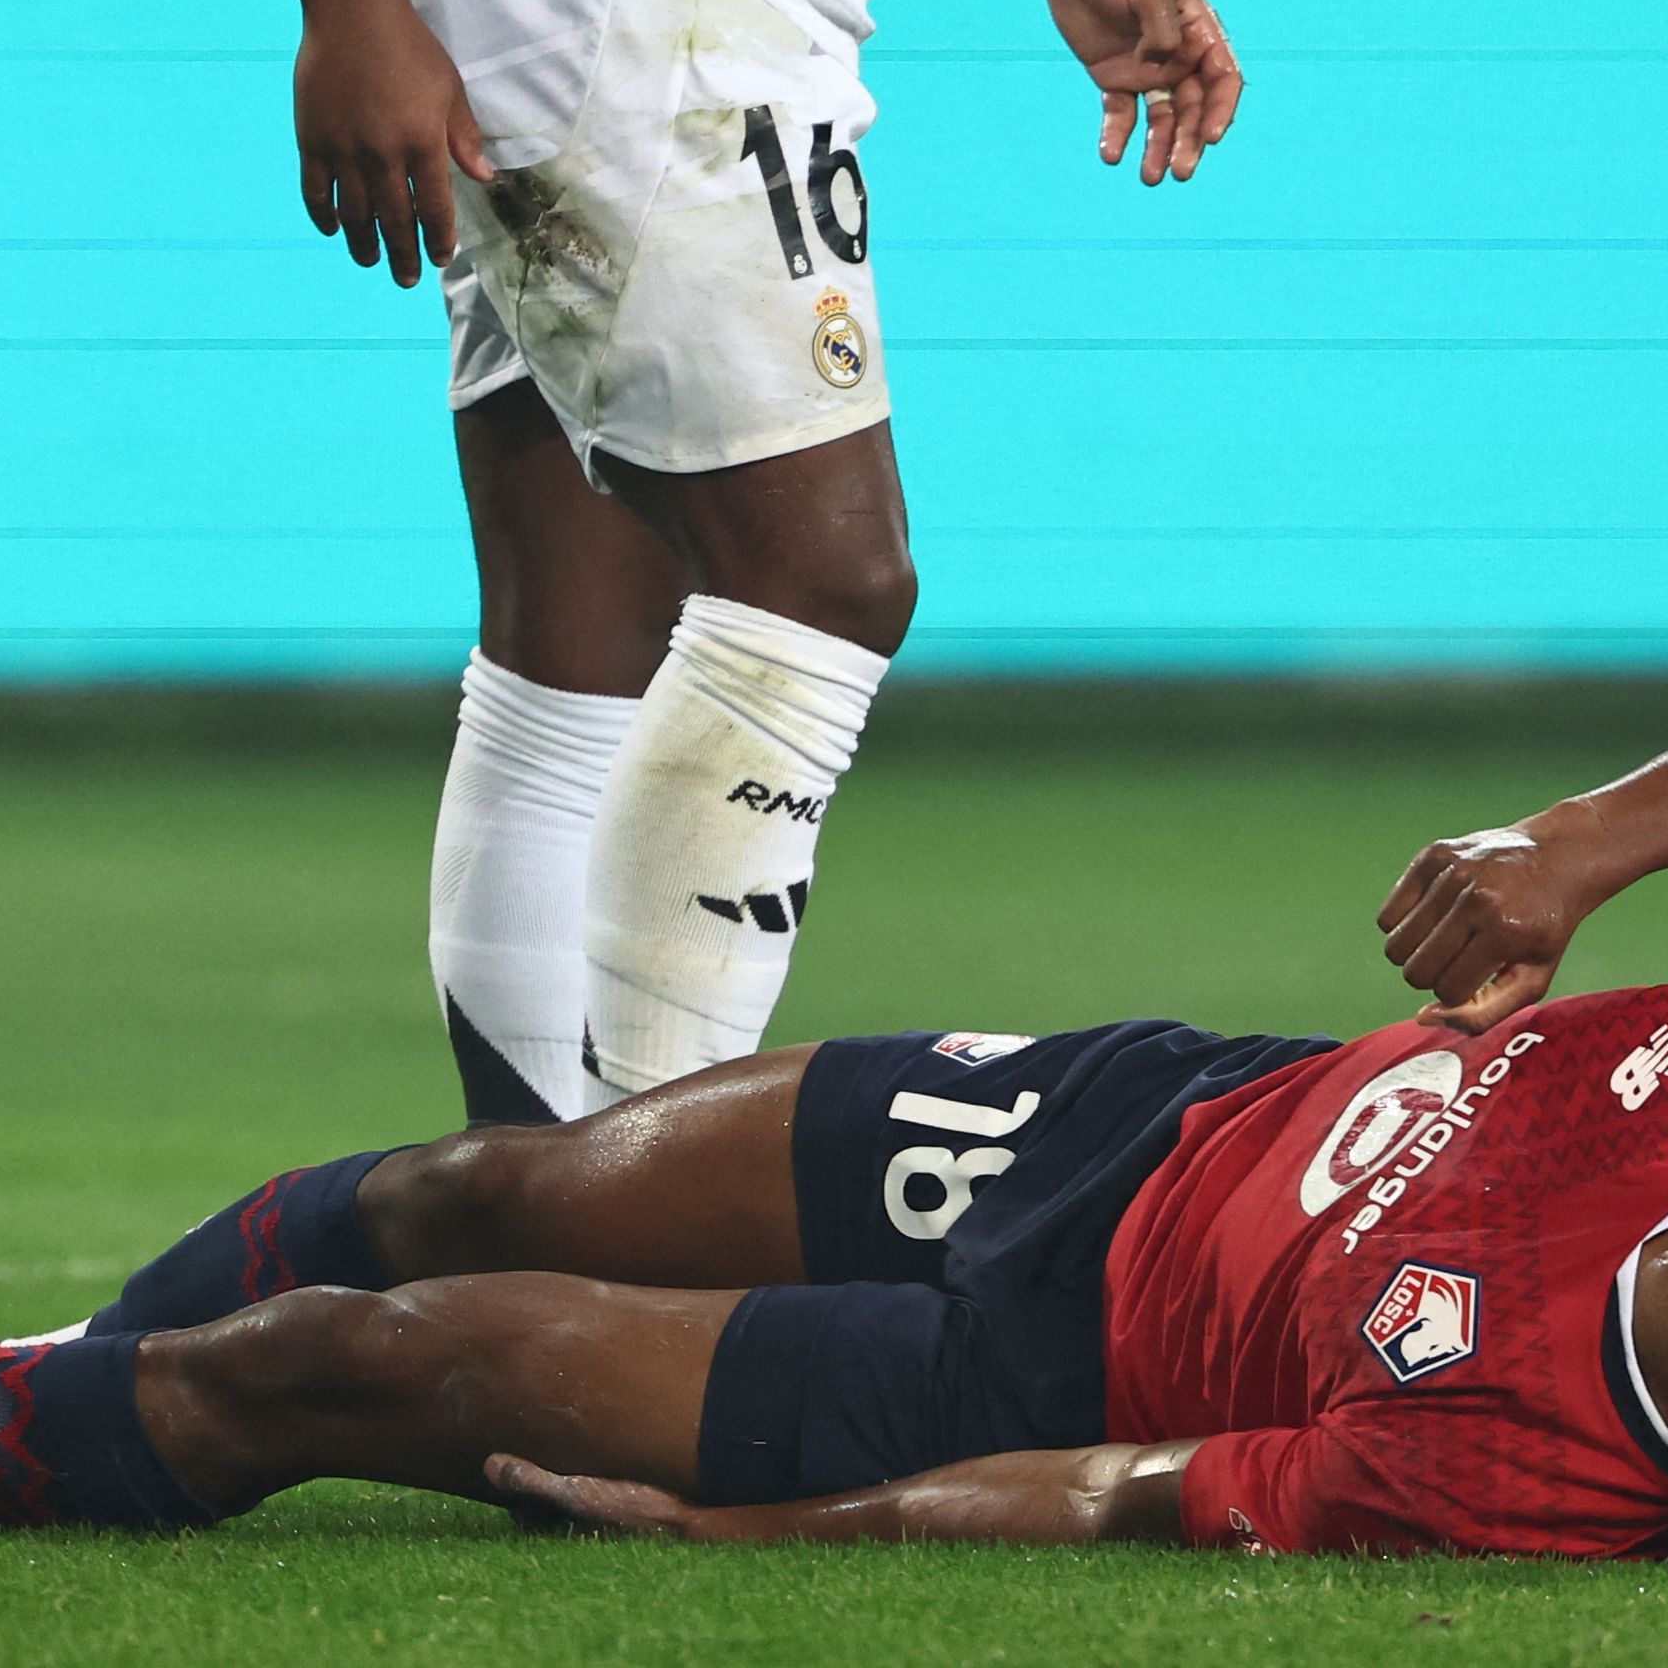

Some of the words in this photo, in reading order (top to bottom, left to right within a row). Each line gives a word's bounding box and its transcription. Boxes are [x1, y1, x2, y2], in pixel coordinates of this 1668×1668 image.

[739, 103, 868, 281] 16
[883, 1089, 1041, 1240] 18
[1341, 1030, 1547, 1255] boulanger
[1372, 1274, 1423, 1336] LOSC
